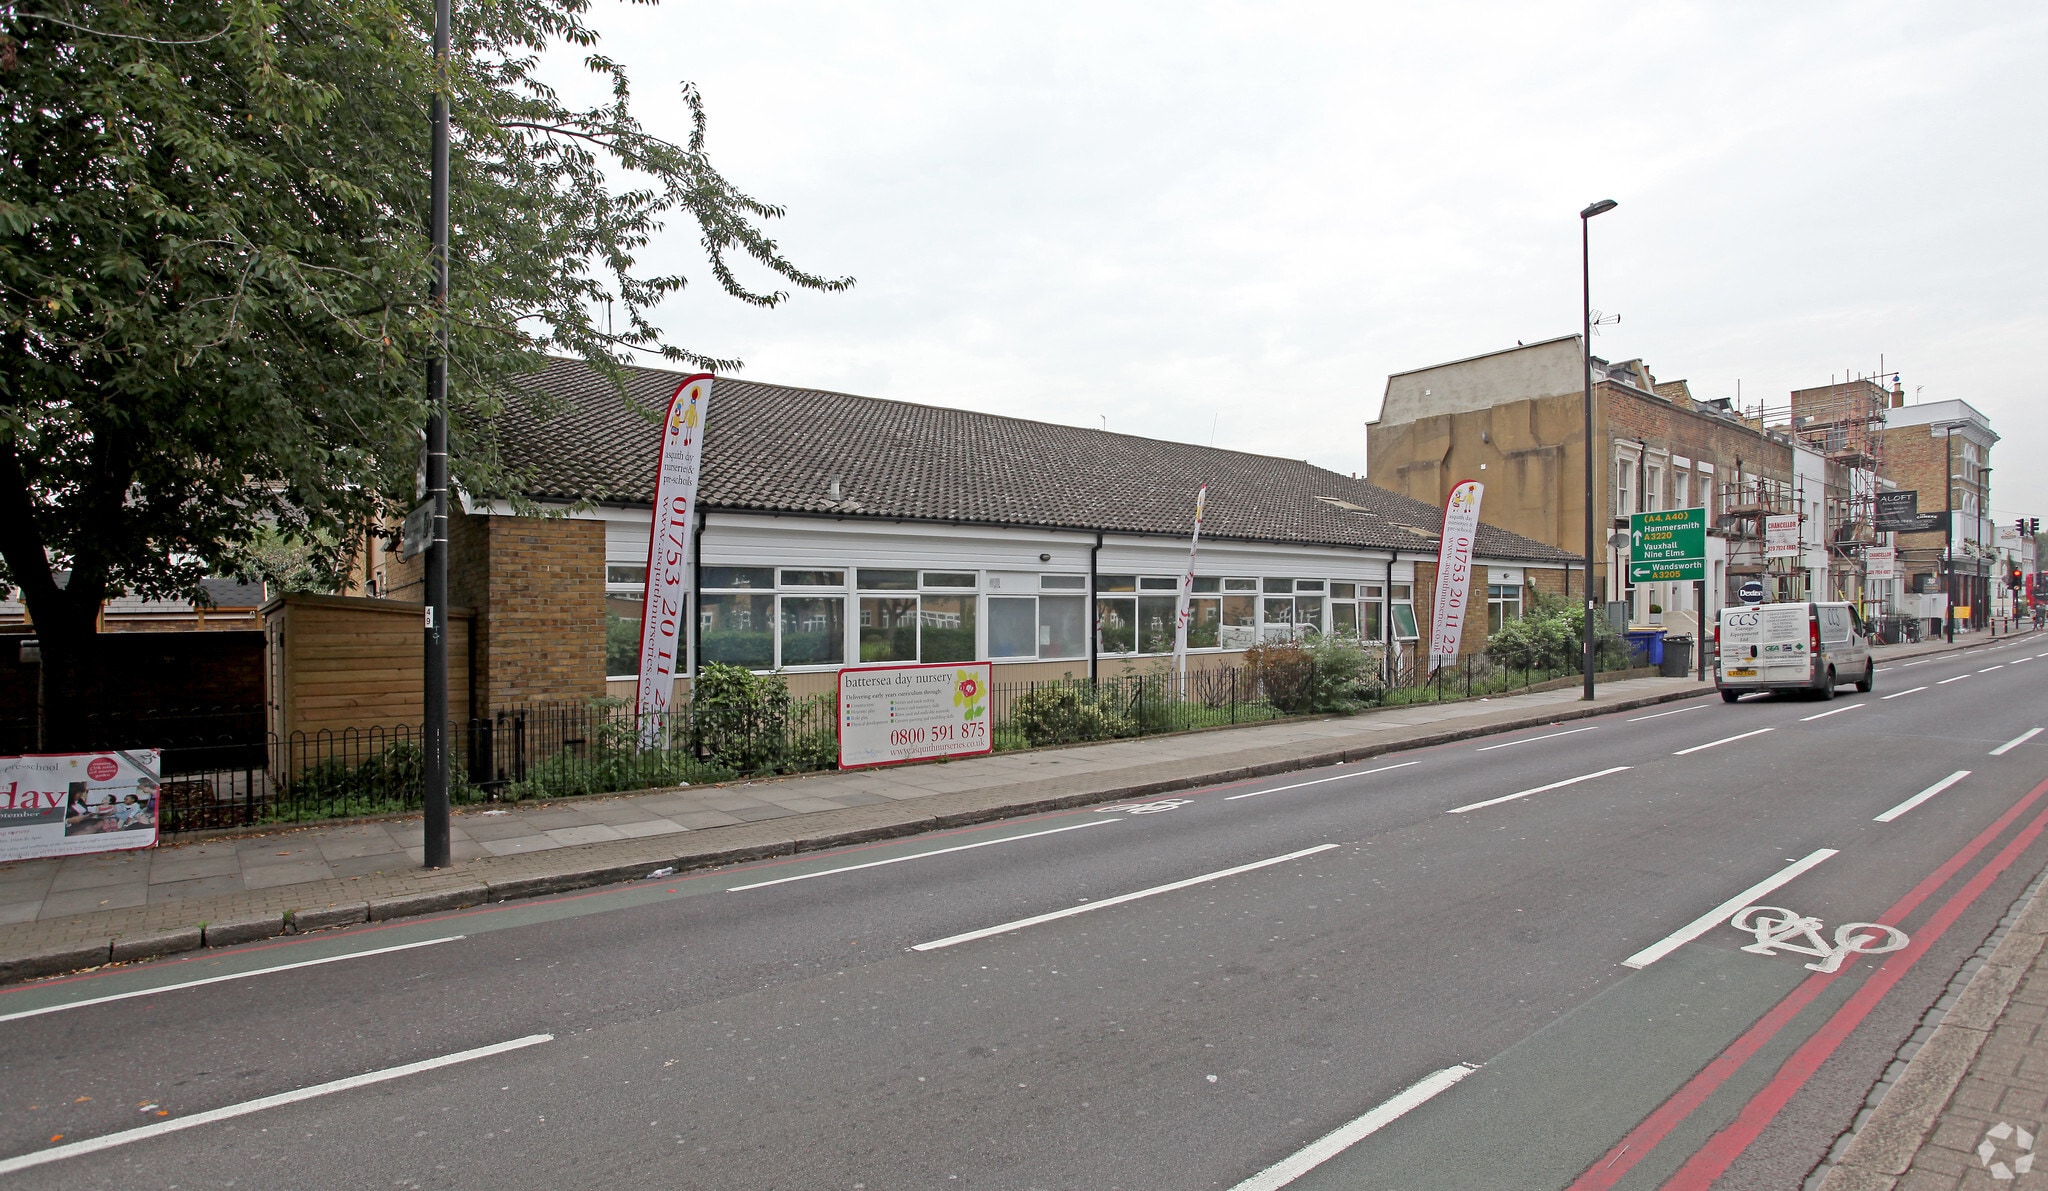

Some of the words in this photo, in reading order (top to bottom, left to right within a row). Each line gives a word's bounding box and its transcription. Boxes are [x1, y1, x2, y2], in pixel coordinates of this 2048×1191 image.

[1644, 522, 1700, 532] Hammersmith
[1644, 532, 1672, 540] A3220
[664, 496, 687, 586] 01753
[1644, 542, 1678, 550] Vauxhall
[1452, 537, 1469, 583] 01753
[1652, 562, 1702, 570] Wandsworth
[642, 496, 668, 716] www.asquithnurseries.co.u
[1449, 589, 1462, 608] 20
[660, 600, 677, 638] 20
[1446, 614, 1458, 630] 11
[1729, 613, 1759, 626] CCS
[1442, 634, 1456, 654] 22
[656, 650, 672, 676] 11
[845, 676, 891, 688] battersea
[895, 673, 912, 687] day
[916, 673, 952, 685] nursery
[891, 727, 925, 746] 0800
[931, 725, 954, 741] 591
[961, 722, 985, 738] 875
[0, 781, 67, 816] day
